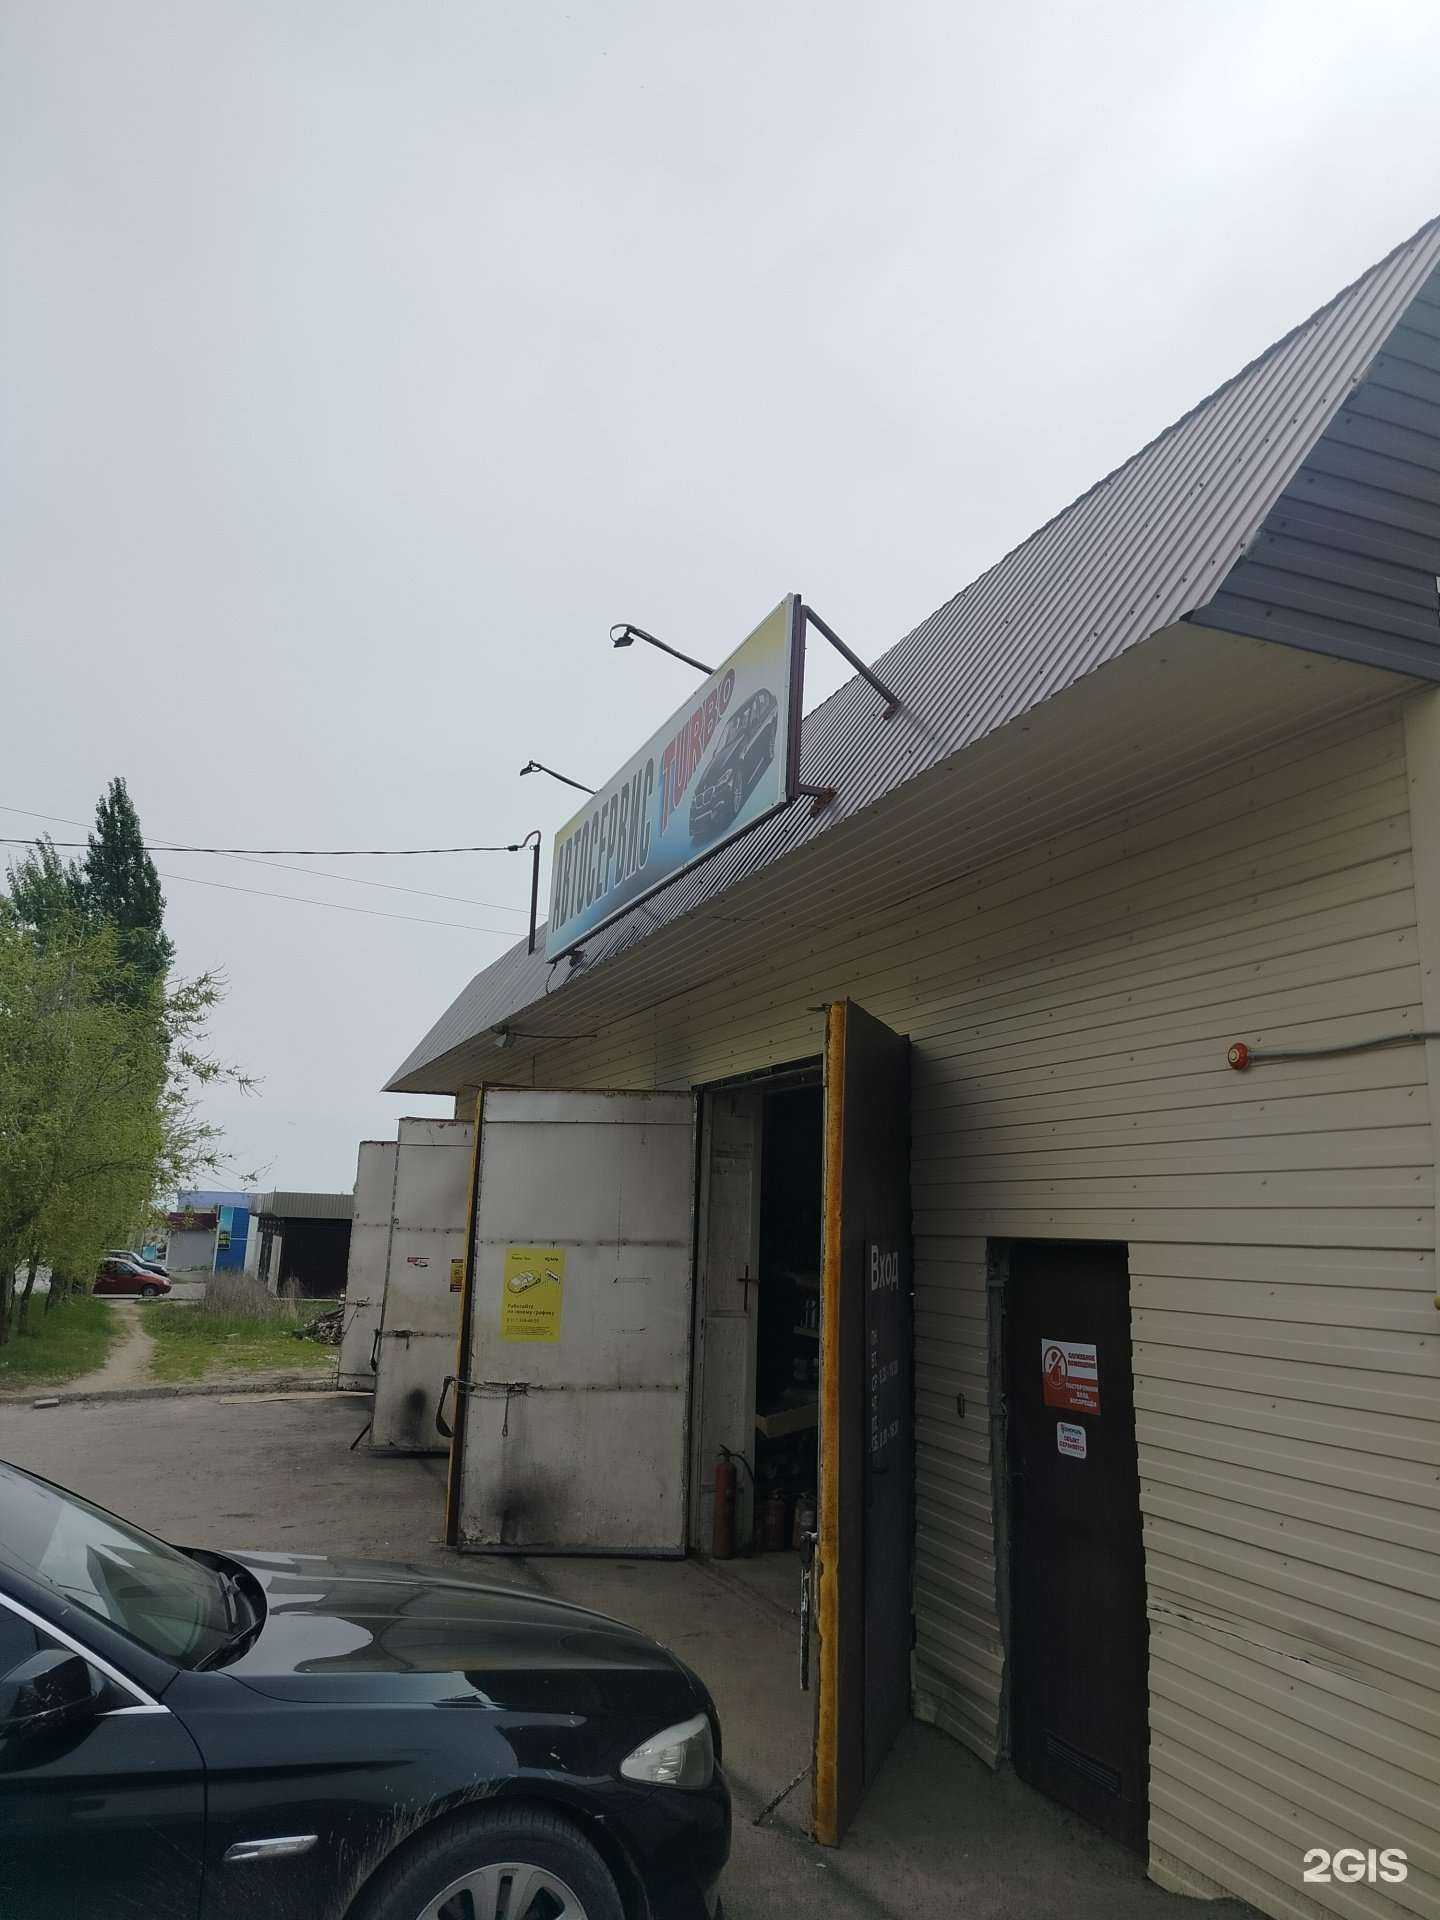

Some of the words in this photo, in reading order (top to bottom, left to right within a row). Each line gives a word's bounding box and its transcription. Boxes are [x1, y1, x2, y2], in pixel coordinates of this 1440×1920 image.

[552, 757, 654, 934] АВТОСЕРВИС
[658, 668, 736, 838] TURBO
[871, 1244, 899, 1292] Вход
